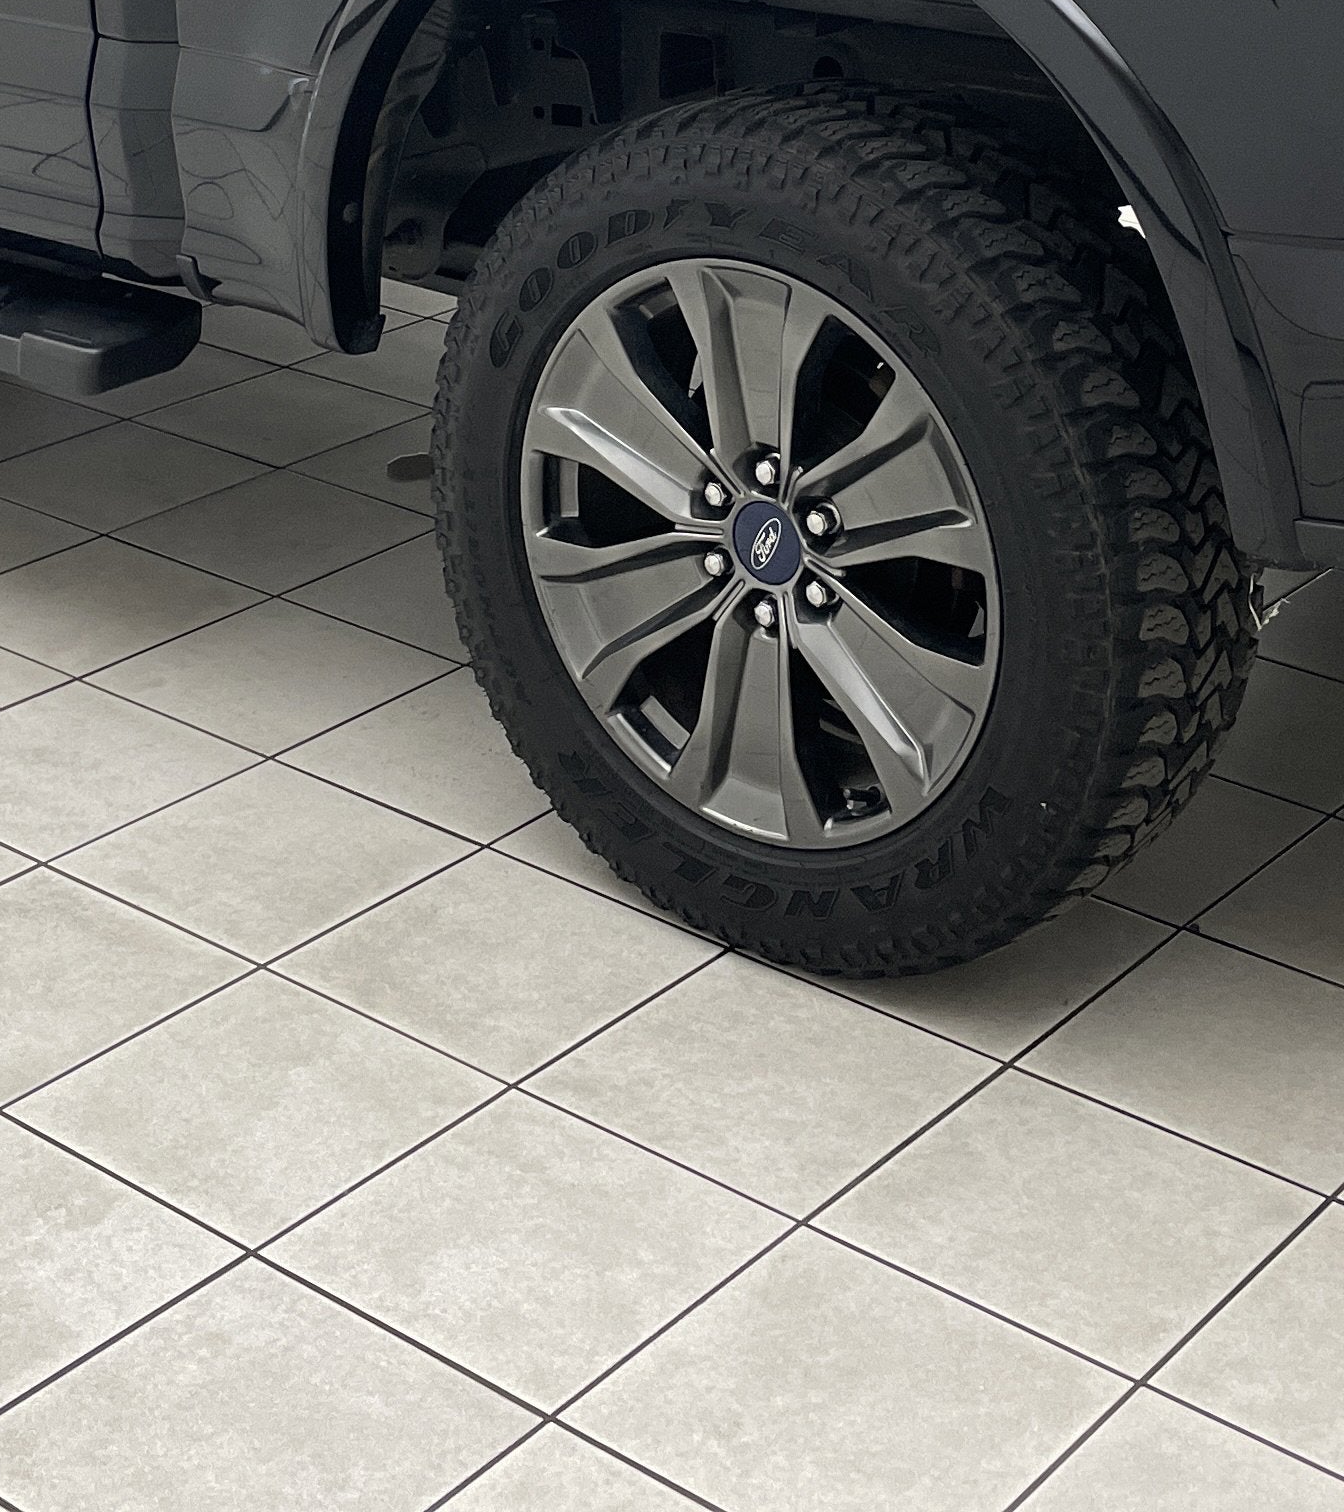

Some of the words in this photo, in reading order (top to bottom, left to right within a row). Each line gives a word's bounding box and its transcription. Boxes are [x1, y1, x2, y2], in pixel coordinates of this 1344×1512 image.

[489, 199, 944, 368] GOODYEAR
[755, 526, 777, 563] Ford
[558, 751, 1012, 921] WRANGLER
